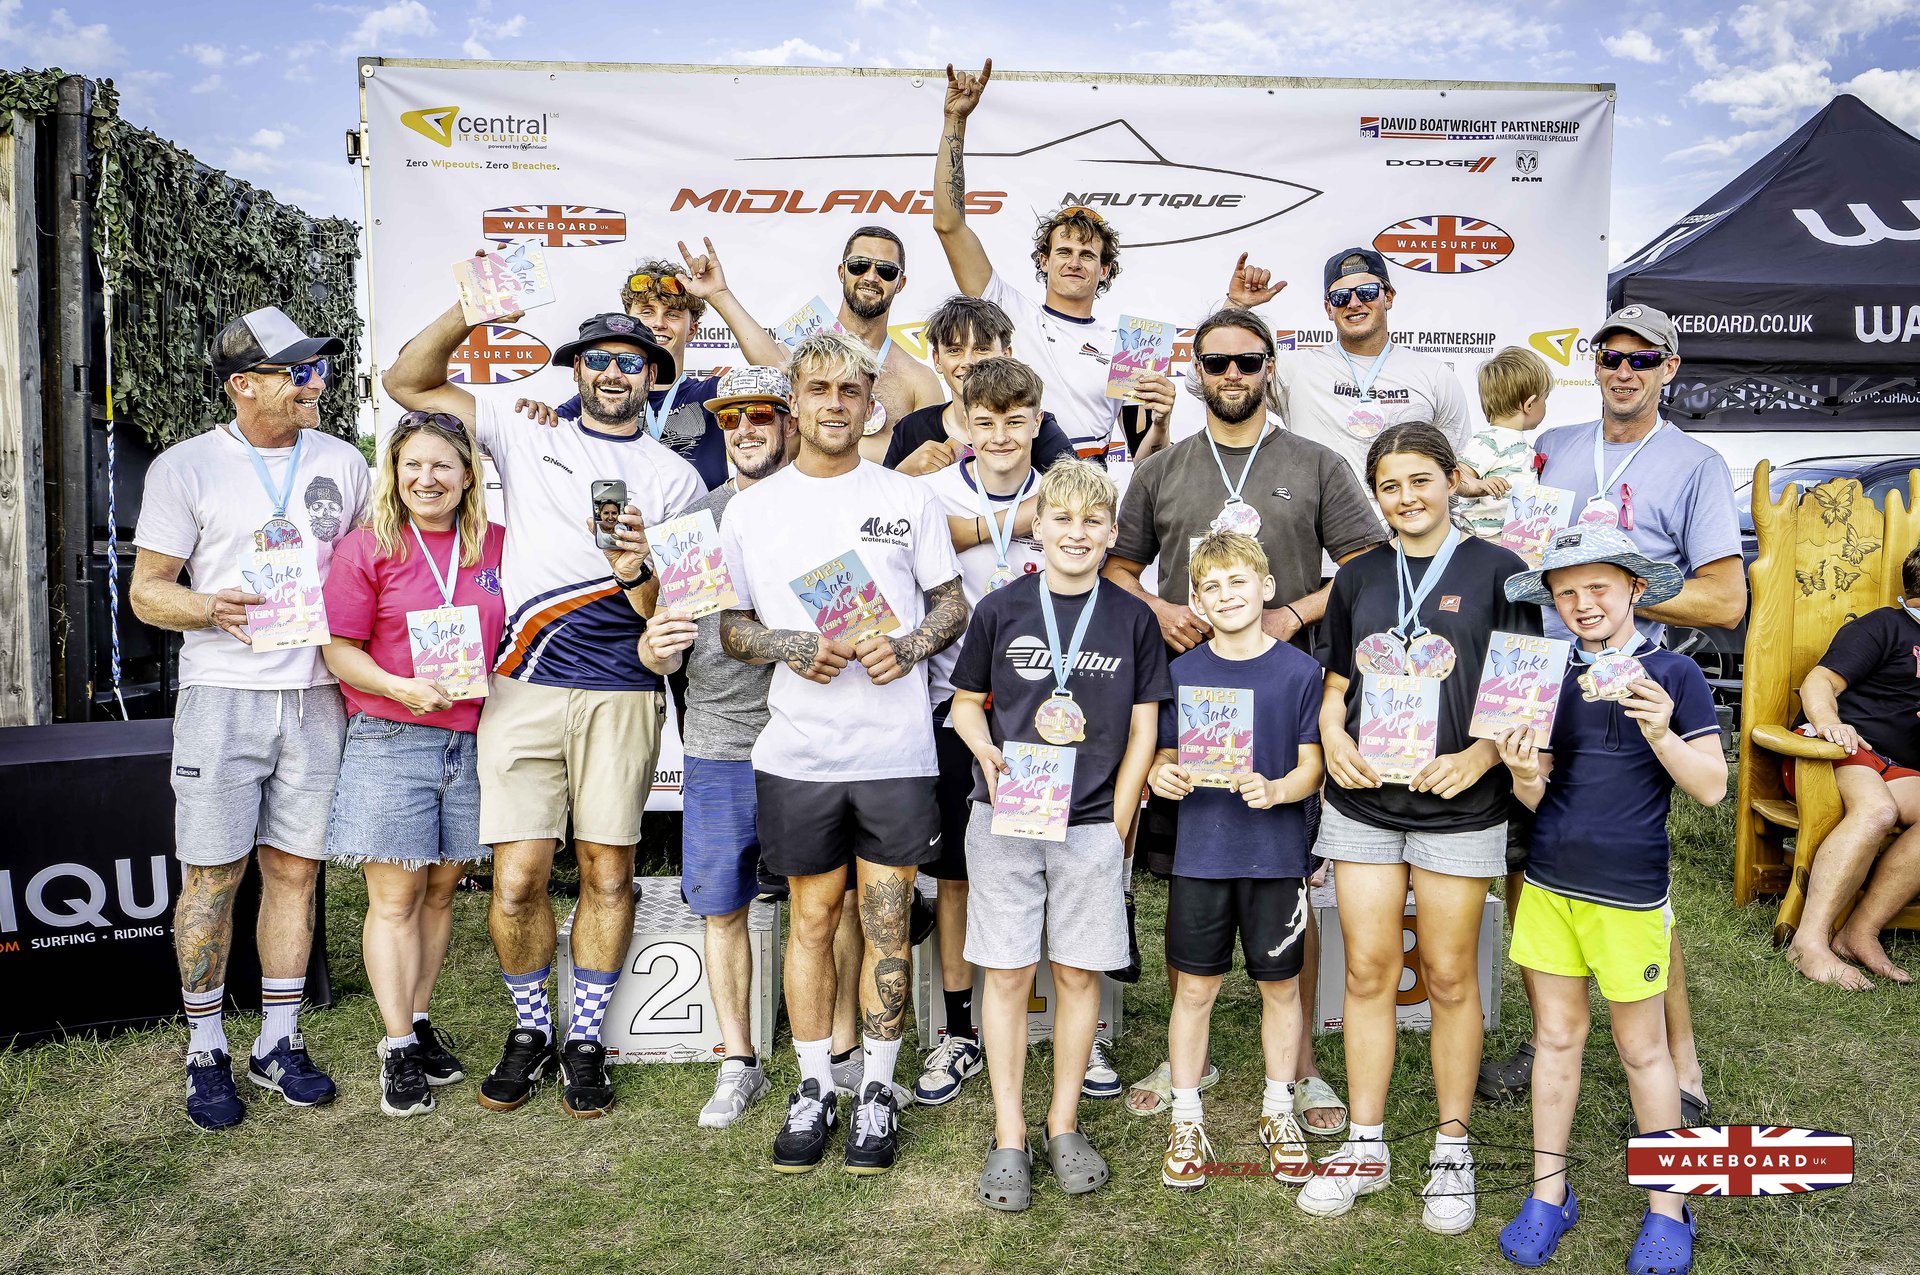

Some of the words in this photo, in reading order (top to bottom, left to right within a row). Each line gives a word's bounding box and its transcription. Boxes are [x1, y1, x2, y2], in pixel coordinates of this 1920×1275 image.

[458, 113, 547, 135] central
[1381, 117, 1417, 132] DAVID
[1420, 118, 1497, 133] BOATWRIGHT
[1501, 120, 1580, 134] PARTNERSHIP
[459, 134, 469, 142] IT
[479, 134, 547, 143] SOLUTIONS
[1526, 134, 1548, 142] VEHICLE
[406, 159, 428, 168] Zero
[431, 160, 482, 169] Wipeouts.
[485, 161, 509, 170] Zero
[513, 161, 560, 171] Breaches.
[1386, 159, 1480, 167] DODGE
[670, 188, 1008, 215] MIDLANDS
[1060, 191, 1244, 208] NAUTIQUE
[503, 221, 598, 231] WAKEBOARD
[1397, 240, 1477, 250] WAKESURF
[1482, 241, 1498, 250] UK
[1672, 314, 1813, 333] KEBOARD.CO.UK
[1297, 330, 1333, 343] DAVID
[1418, 332, 1496, 346] PARTNERSHIP
[452, 351, 512, 359] KESURF
[803, 559, 846, 587] 2025
[1193, 689, 1237, 704] 2025
[31, 932, 96, 949] SURFING
[114, 925, 164, 940] RIDING
[630, 941, 703, 1036] 2
